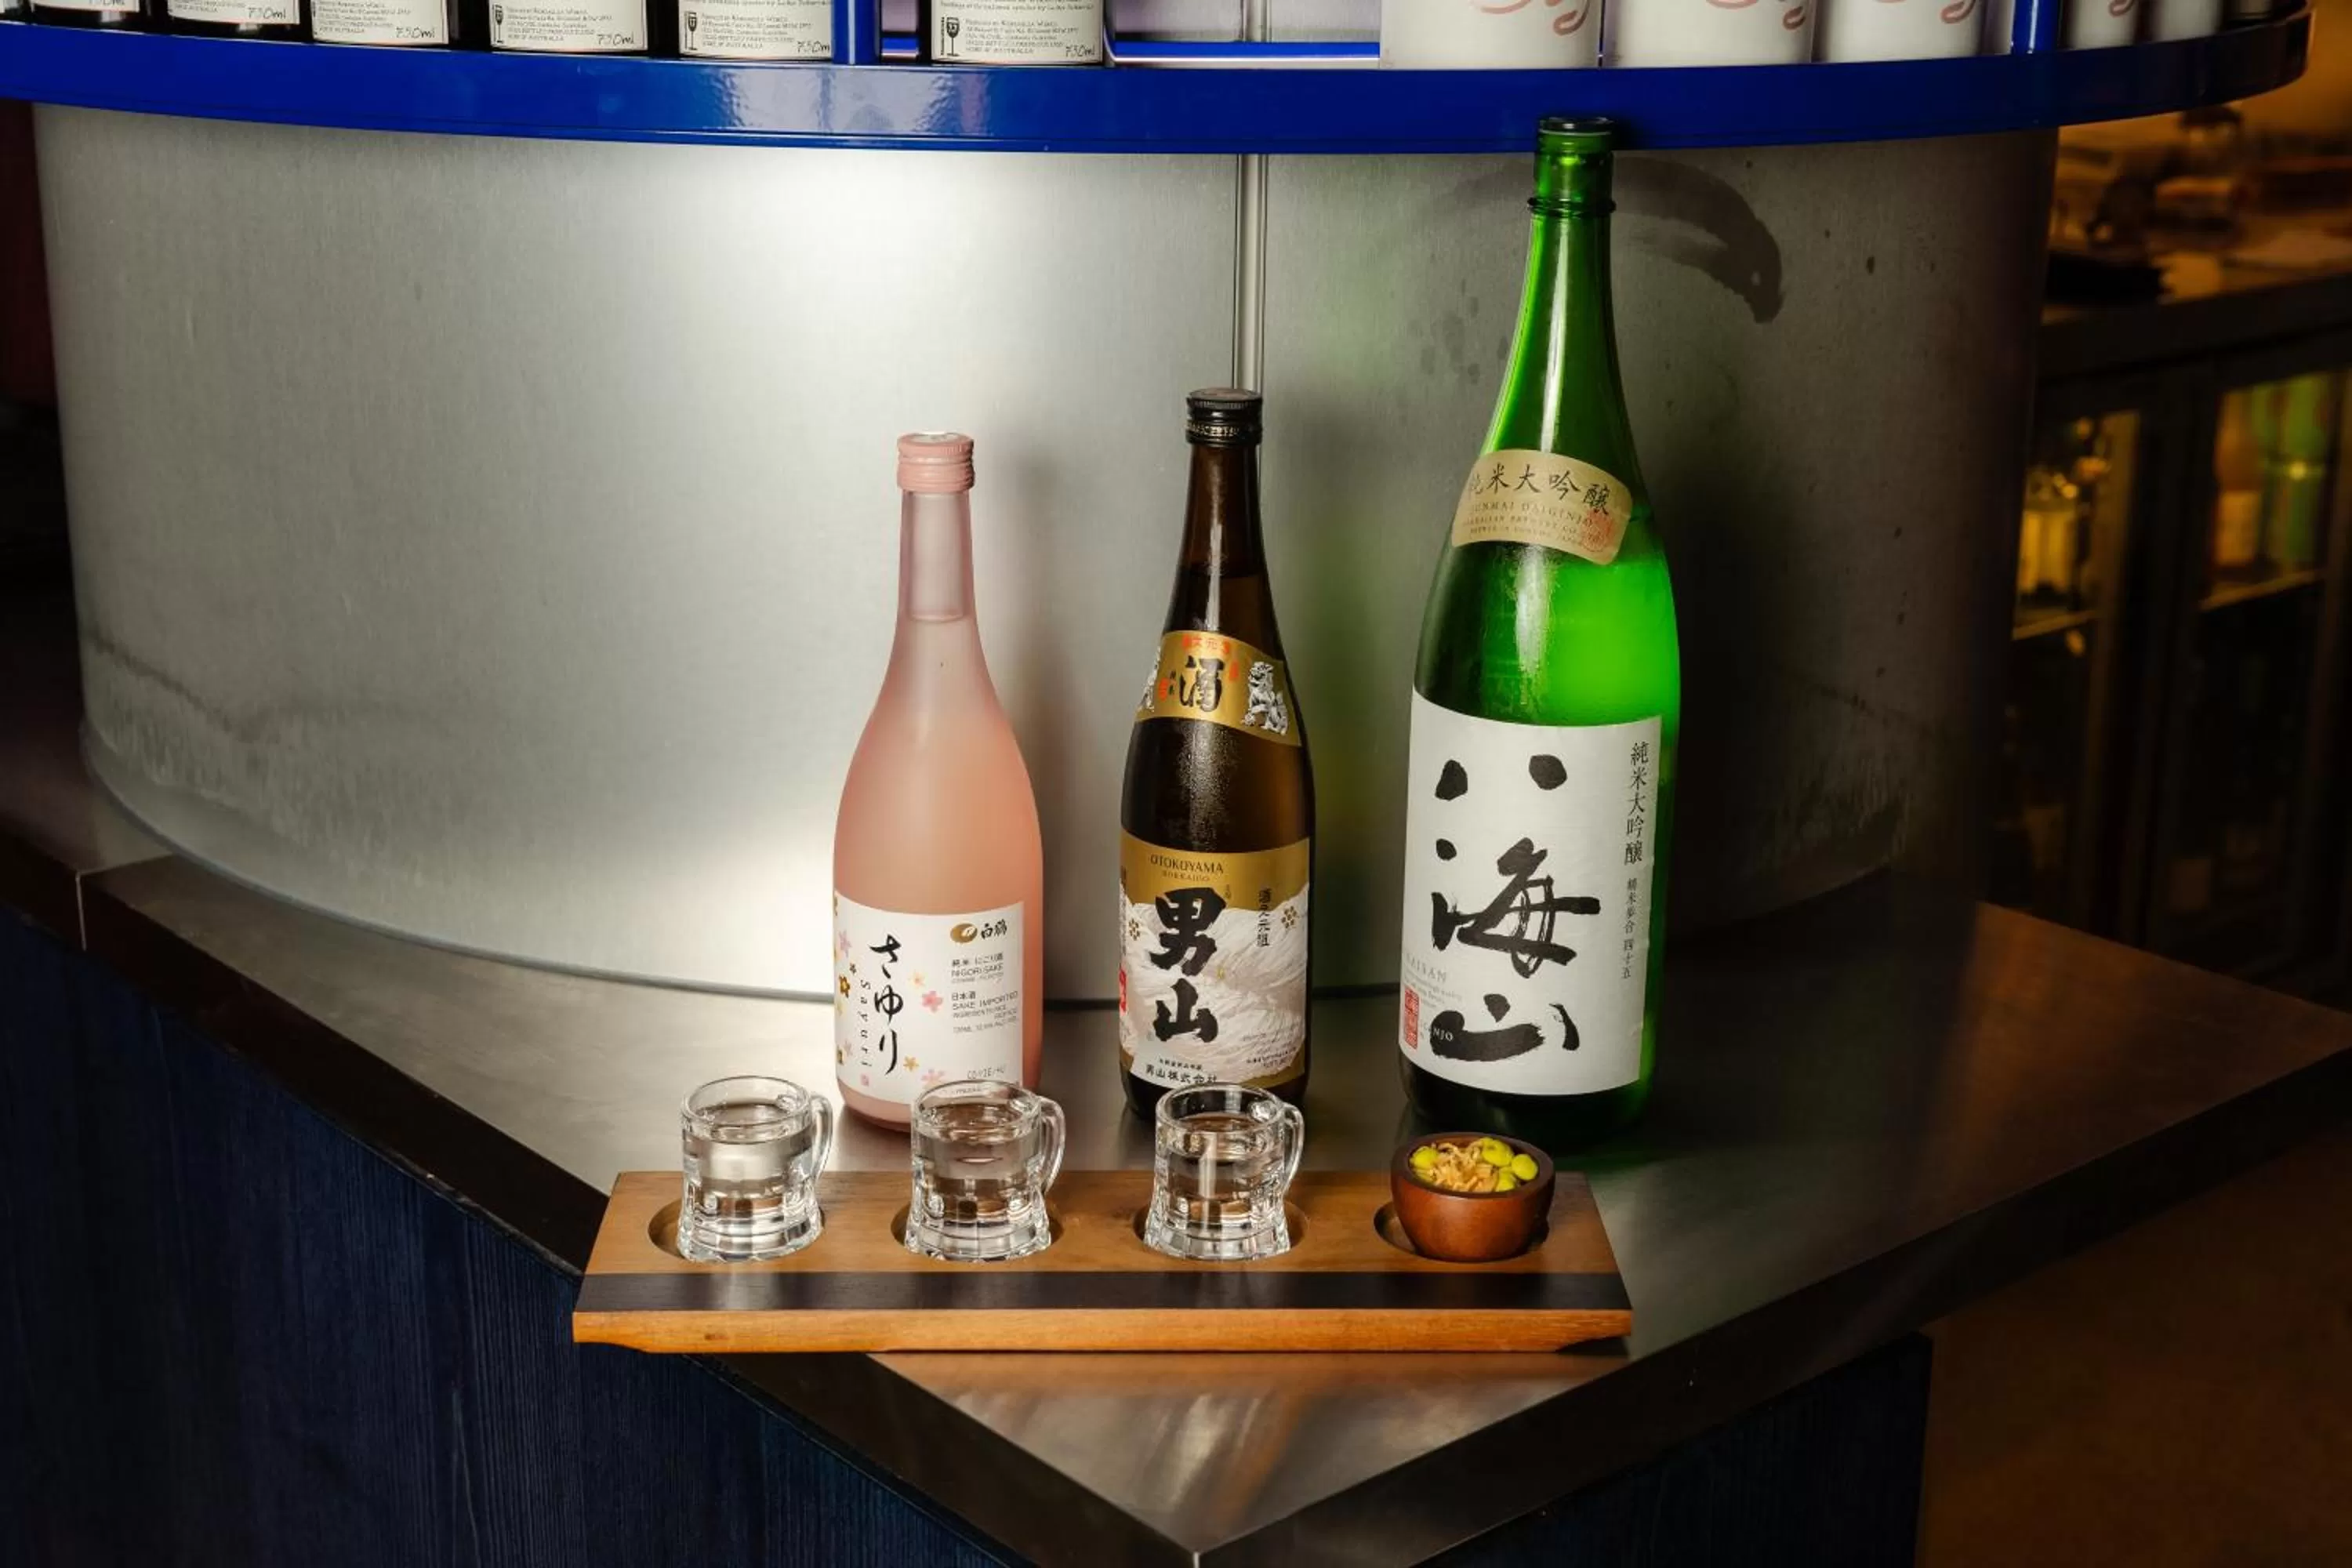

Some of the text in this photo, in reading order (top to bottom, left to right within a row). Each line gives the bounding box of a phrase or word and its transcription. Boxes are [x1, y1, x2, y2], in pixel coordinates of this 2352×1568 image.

[1149, 854, 1224, 873] OTOKOYAMA
[867, 934, 904, 1076] さゆり
[1149, 887, 1227, 1044] 男山
